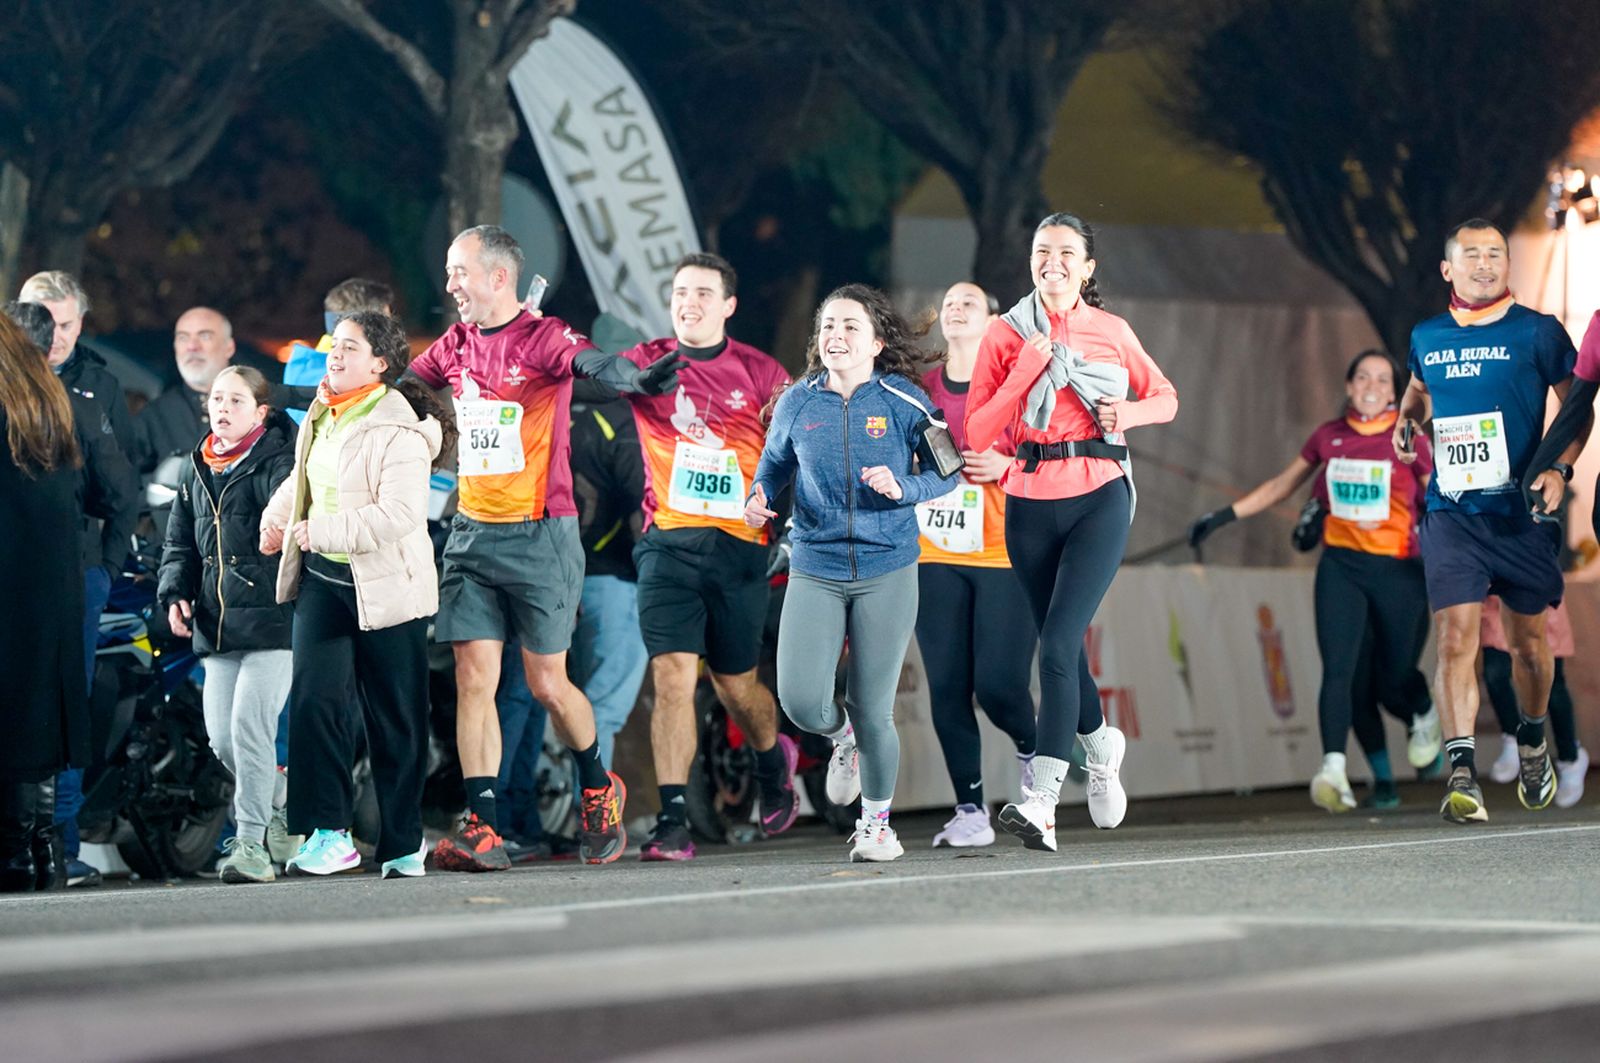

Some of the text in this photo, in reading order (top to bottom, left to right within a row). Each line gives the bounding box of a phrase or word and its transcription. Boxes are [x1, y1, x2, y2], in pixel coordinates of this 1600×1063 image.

[1424, 346, 1511, 366] CAJA RURAL
[1445, 362, 1482, 379] JAÉN
[470, 427, 500, 449] 532
[686, 422, 706, 439] 43
[1447, 441, 1490, 465] 2073
[686, 470, 732, 495] 7936
[926, 508, 966, 530] 7574
